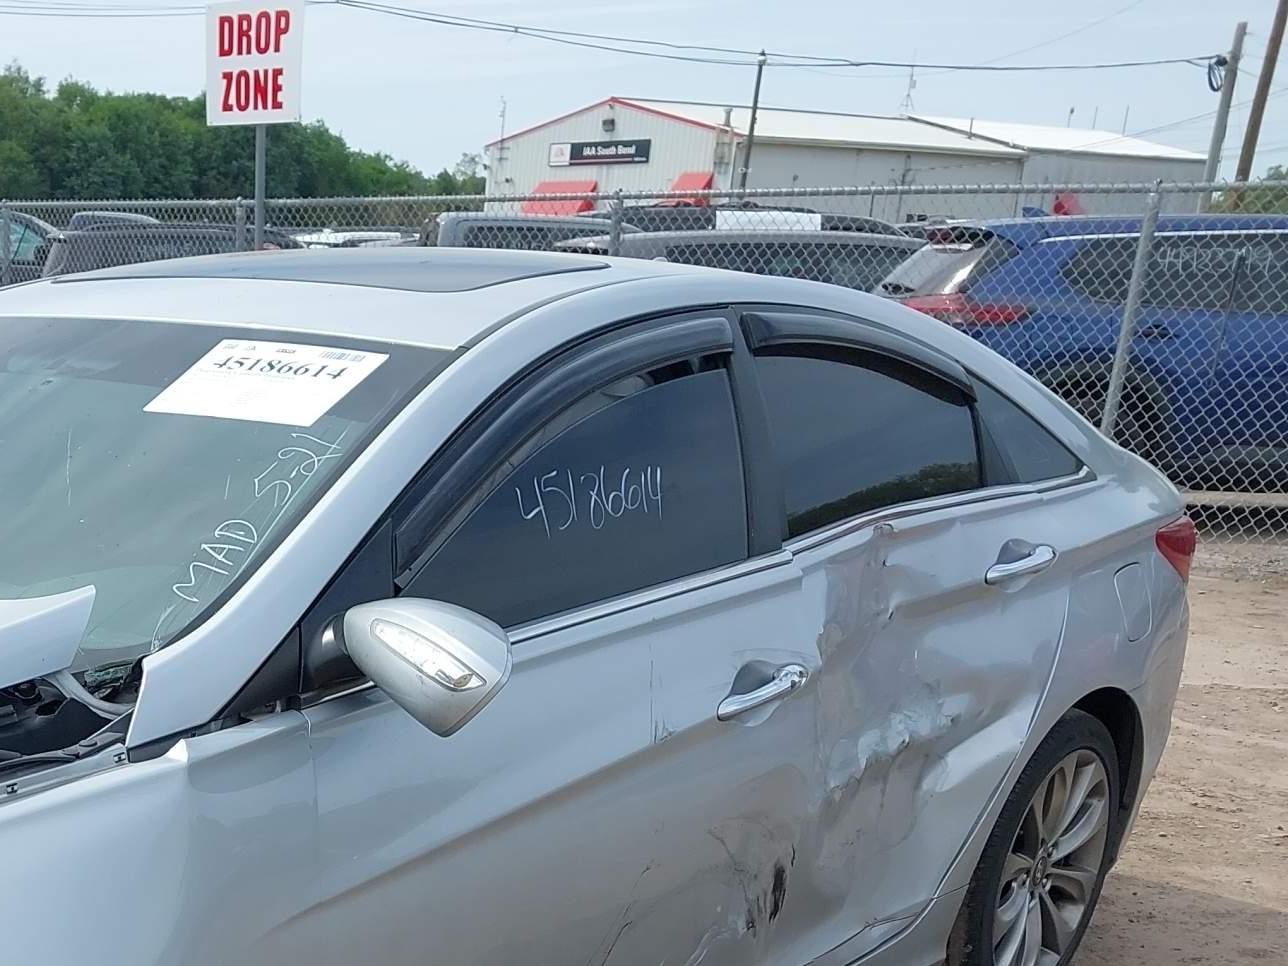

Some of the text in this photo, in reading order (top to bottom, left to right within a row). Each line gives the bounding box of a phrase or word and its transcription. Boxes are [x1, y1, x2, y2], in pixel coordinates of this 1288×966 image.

[218, 9, 290, 57] DROP
[221, 67, 284, 112] ZONE
[213, 355, 349, 380] 45186614
[172, 433, 344, 603] MAD 5-21
[515, 465, 663, 539] 45186614
